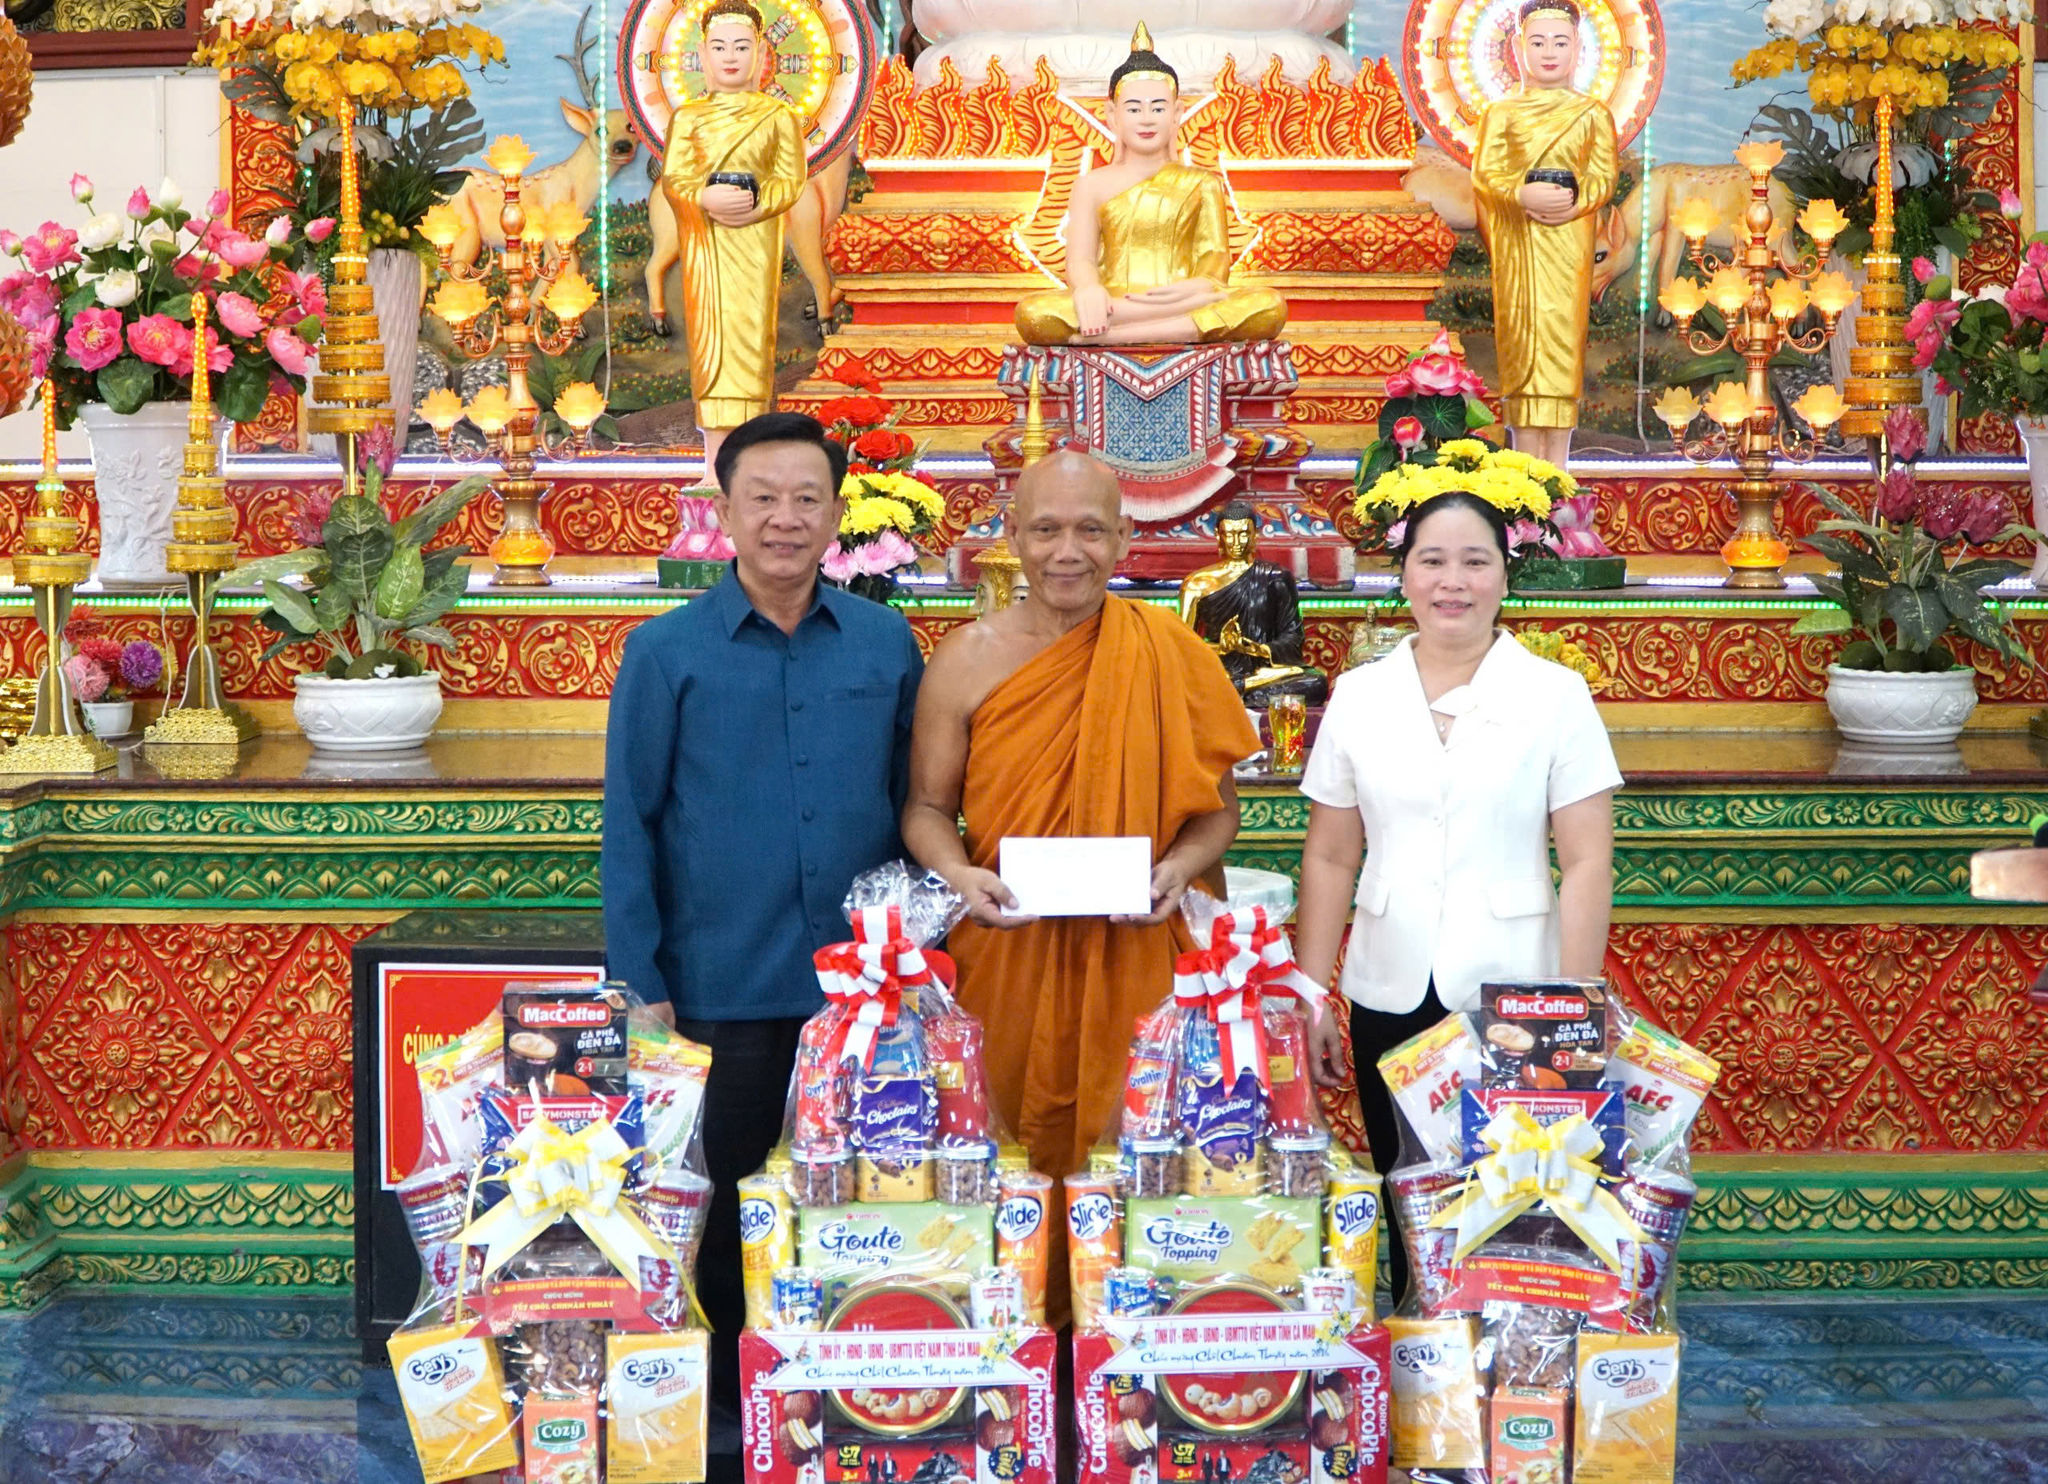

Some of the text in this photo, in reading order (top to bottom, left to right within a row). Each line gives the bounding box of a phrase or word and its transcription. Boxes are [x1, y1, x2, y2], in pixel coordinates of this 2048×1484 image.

[523, 1004, 606, 1023] MacCoffee
[1501, 998, 1584, 1015] MacCoffee
[596, 1027, 615, 1038] PHÊ
[1573, 1020, 1593, 1031] PHÊ
[577, 1038, 602, 1050] ĐEN
[1554, 1032, 1580, 1042] ĐEN
[1429, 1069, 1464, 1115] AFC
[1626, 1084, 1674, 1112] AFC
[522, 1109, 602, 1120] BAYMONSTER
[866, 1105, 918, 1125] Choclairs
[1335, 1198, 1375, 1233] Slide
[819, 1222, 903, 1251] Gouté
[1161, 1246, 1218, 1262] Topping
[1263, 1325, 1276, 1341] NAM
[928, 1342, 941, 1358] NAM
[1394, 1344, 1440, 1373] Gery
[408, 1353, 457, 1385] Gery
[622, 1357, 674, 1388] Gery
[1593, 1357, 1645, 1388] Gery
[744, 1397, 753, 1434] ORION
[1379, 1402, 1388, 1438] ORION
[541, 1424, 580, 1439] Cozy
[1509, 1420, 1549, 1436] Cozy
[839, 1445, 861, 1459] G7
[1173, 1443, 1195, 1457] G7
